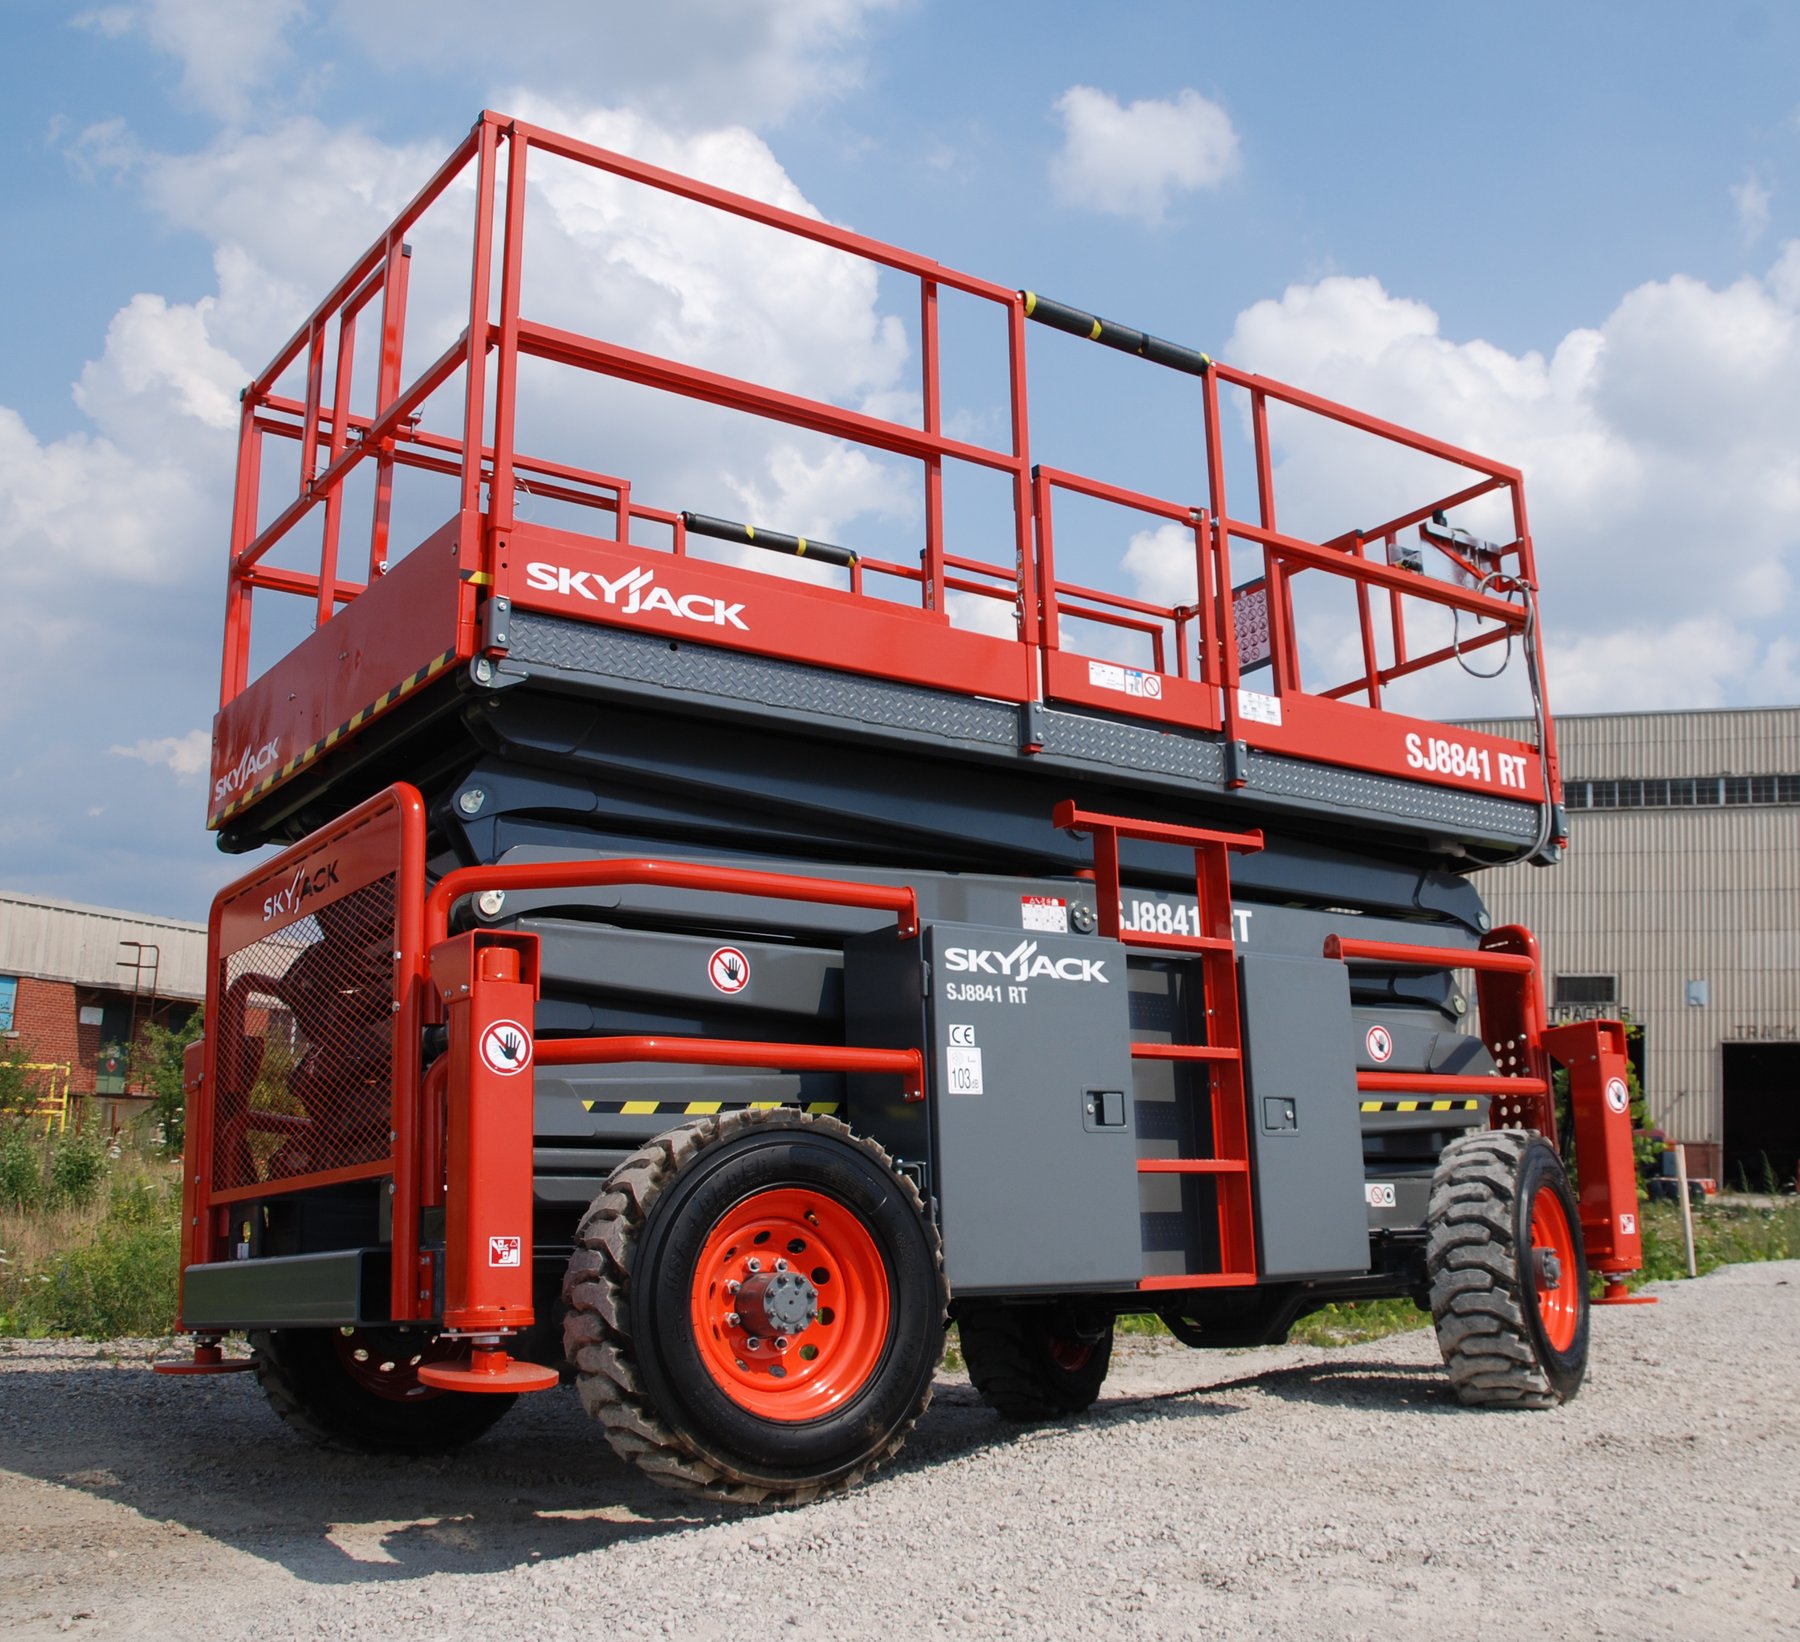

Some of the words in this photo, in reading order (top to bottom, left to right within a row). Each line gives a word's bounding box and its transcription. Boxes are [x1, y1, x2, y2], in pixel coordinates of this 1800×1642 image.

[526, 562, 750, 631] SKYJACK
[214, 736, 280, 802] SKYJACK
[1405, 733, 1491, 782] SJ8841
[1498, 752, 1527, 789] RT
[263, 860, 339, 922] SKYJACK
[1231, 909, 1252, 943] T
[944, 940, 1109, 983] SKYJACK
[946, 983, 1002, 1003] SJ8841
[1008, 986, 1028, 1004] RT
[1547, 1006, 1606, 1022] TRACK
[952, 1067, 971, 1089] 103
